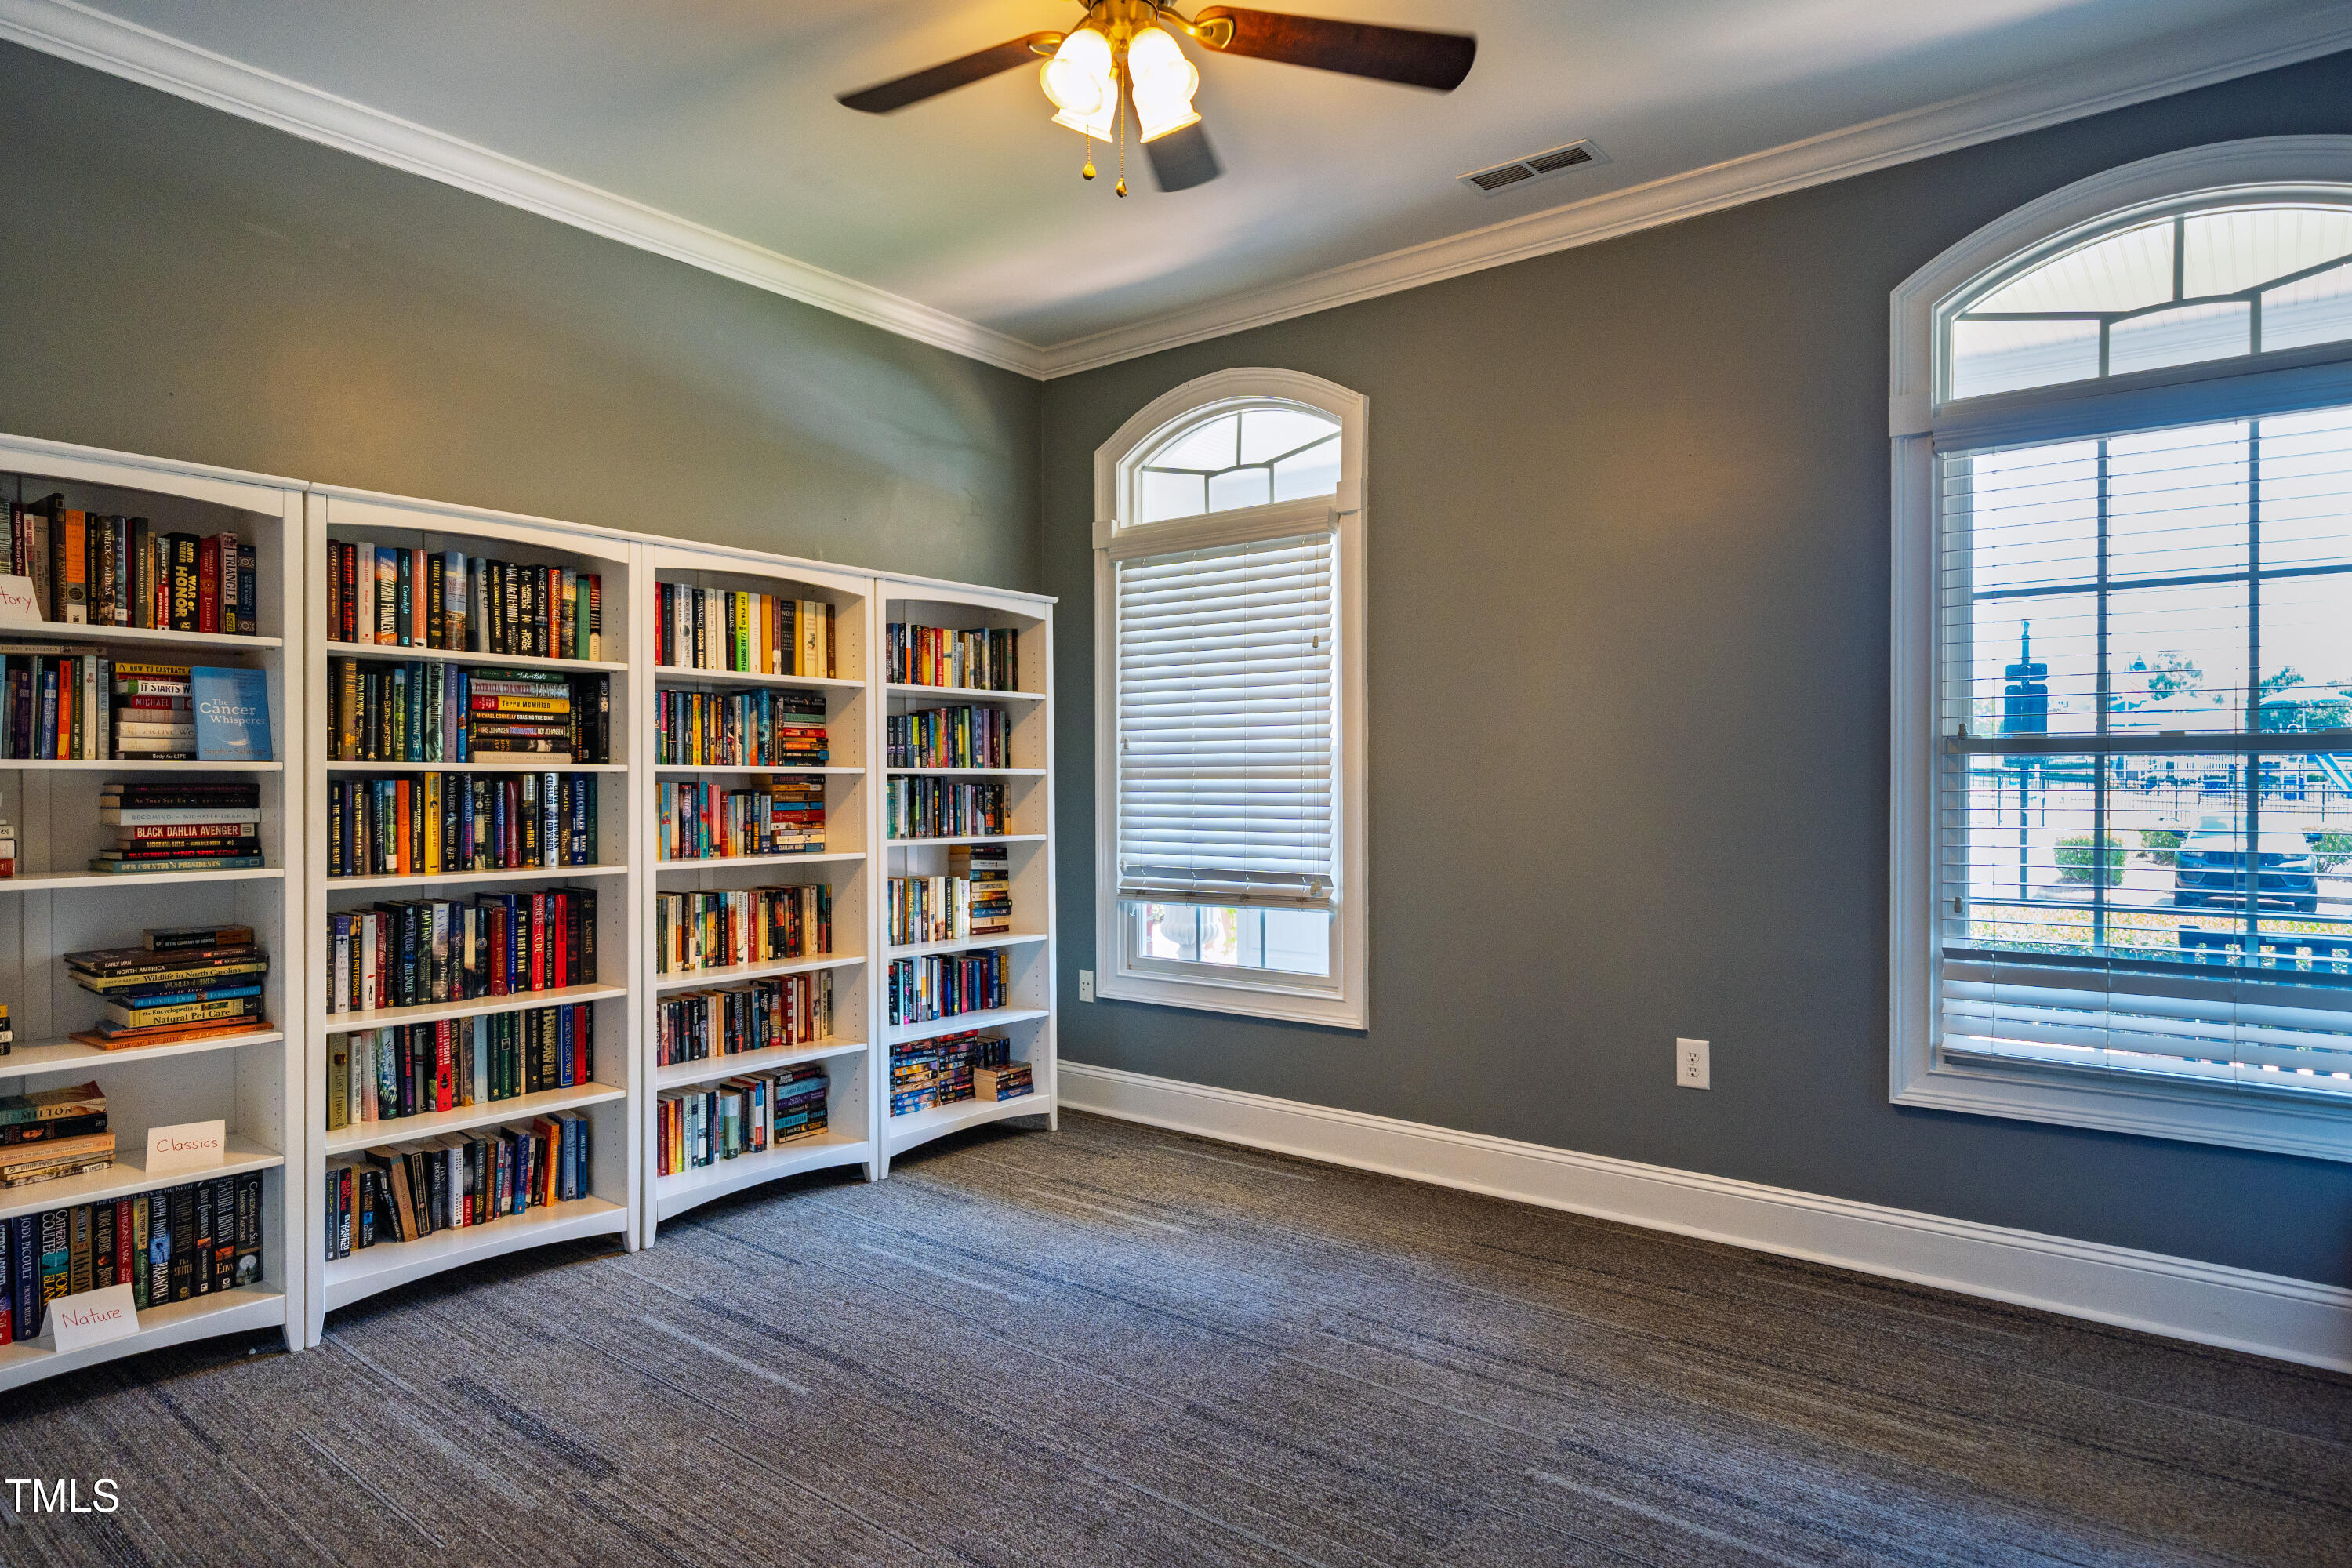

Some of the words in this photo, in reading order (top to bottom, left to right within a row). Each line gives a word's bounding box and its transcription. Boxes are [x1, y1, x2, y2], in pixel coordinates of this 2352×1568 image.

[226, 553, 236, 600] TRIANGLE
[380, 564, 395, 601] JONATHAN
[506, 568, 517, 581] VAL
[0, 586, 32, 614] tory
[175, 566, 187, 618] HONOR
[590, 588, 601, 612] NEVADA
[188, 602, 194, 611] OF
[506, 583, 519, 623] McDERMID
[380, 603, 395, 636] FRANZEN
[590, 613, 601, 630] BARR
[355, 674, 364, 691] SYLVIA
[430, 665, 442, 700] Catherine
[474, 682, 501, 693] PATRICIA
[502, 684, 531, 695] CORNWELL
[136, 698, 170, 707] MICHAEL
[199, 702, 256, 714] Cancer
[430, 701, 442, 725] Coulter
[210, 714, 267, 726] Whisperer
[576, 780, 585, 800] CLIVE
[576, 800, 586, 831] CUSSLER
[136, 826, 163, 838] BLACK
[166, 826, 198, 837] DAHLIA
[200, 824, 239, 837] AVENGER
[332, 816, 341, 846] WARRIOR'S
[216, 848, 240, 857] ZONE
[136, 862, 176, 870] COUNTRY'S
[177, 860, 221, 869] PRESIDENTS
[421, 909, 432, 925] AMY
[535, 895, 543, 925] SECRETS
[421, 926, 432, 941] TAN
[437, 909, 446, 941] EVANS
[517, 925, 526, 934] THE
[517, 937, 527, 950] RISE
[535, 933, 543, 953] CODE
[585, 919, 593, 954] LASHER
[352, 938, 361, 959] JAMES
[440, 952, 448, 964] The
[139, 964, 165, 973] AMERICA
[143, 974, 174, 984] Wildlife
[185, 971, 209, 979] North
[210, 967, 241, 977] Carolina
[517, 959, 527, 973] NINE
[152, 1007, 193, 1015] Encyclopedia
[154, 1014, 187, 1025] Natural
[191, 1011, 206, 1022] Pet
[208, 1009, 230, 1019] Care
[147, 1036, 183, 1046] REVISITED
[543, 1009, 557, 1064] HARMONY
[336, 1073, 345, 1094] LOST
[21, 1107, 73, 1120] MILTON
[336, 1094, 345, 1123] THRONE
[156, 1138, 219, 1153] Classics
[199, 1189, 210, 1205] DIANE
[217, 1181, 234, 1214] SANDRA
[175, 1192, 194, 1224] SANDRA
[20, 1217, 31, 1238] JODI
[97, 1210, 112, 1229] NORA
[197, 1203, 212, 1240] CHAMBERLAIN
[217, 1213, 234, 1244] BROWN
[239, 1214, 249, 1242] FALCONES
[42, 1212, 56, 1258] COULTER
[54, 1210, 69, 1254] CATHERINE
[94, 1228, 113, 1254] ROBERTS
[174, 1224, 194, 1254] BROWN
[21, 1240, 32, 1280] PICOULT
[216, 1262, 235, 1277] Envy
[152, 1261, 169, 1300] PARANOIA
[62, 1307, 122, 1329] Nature
